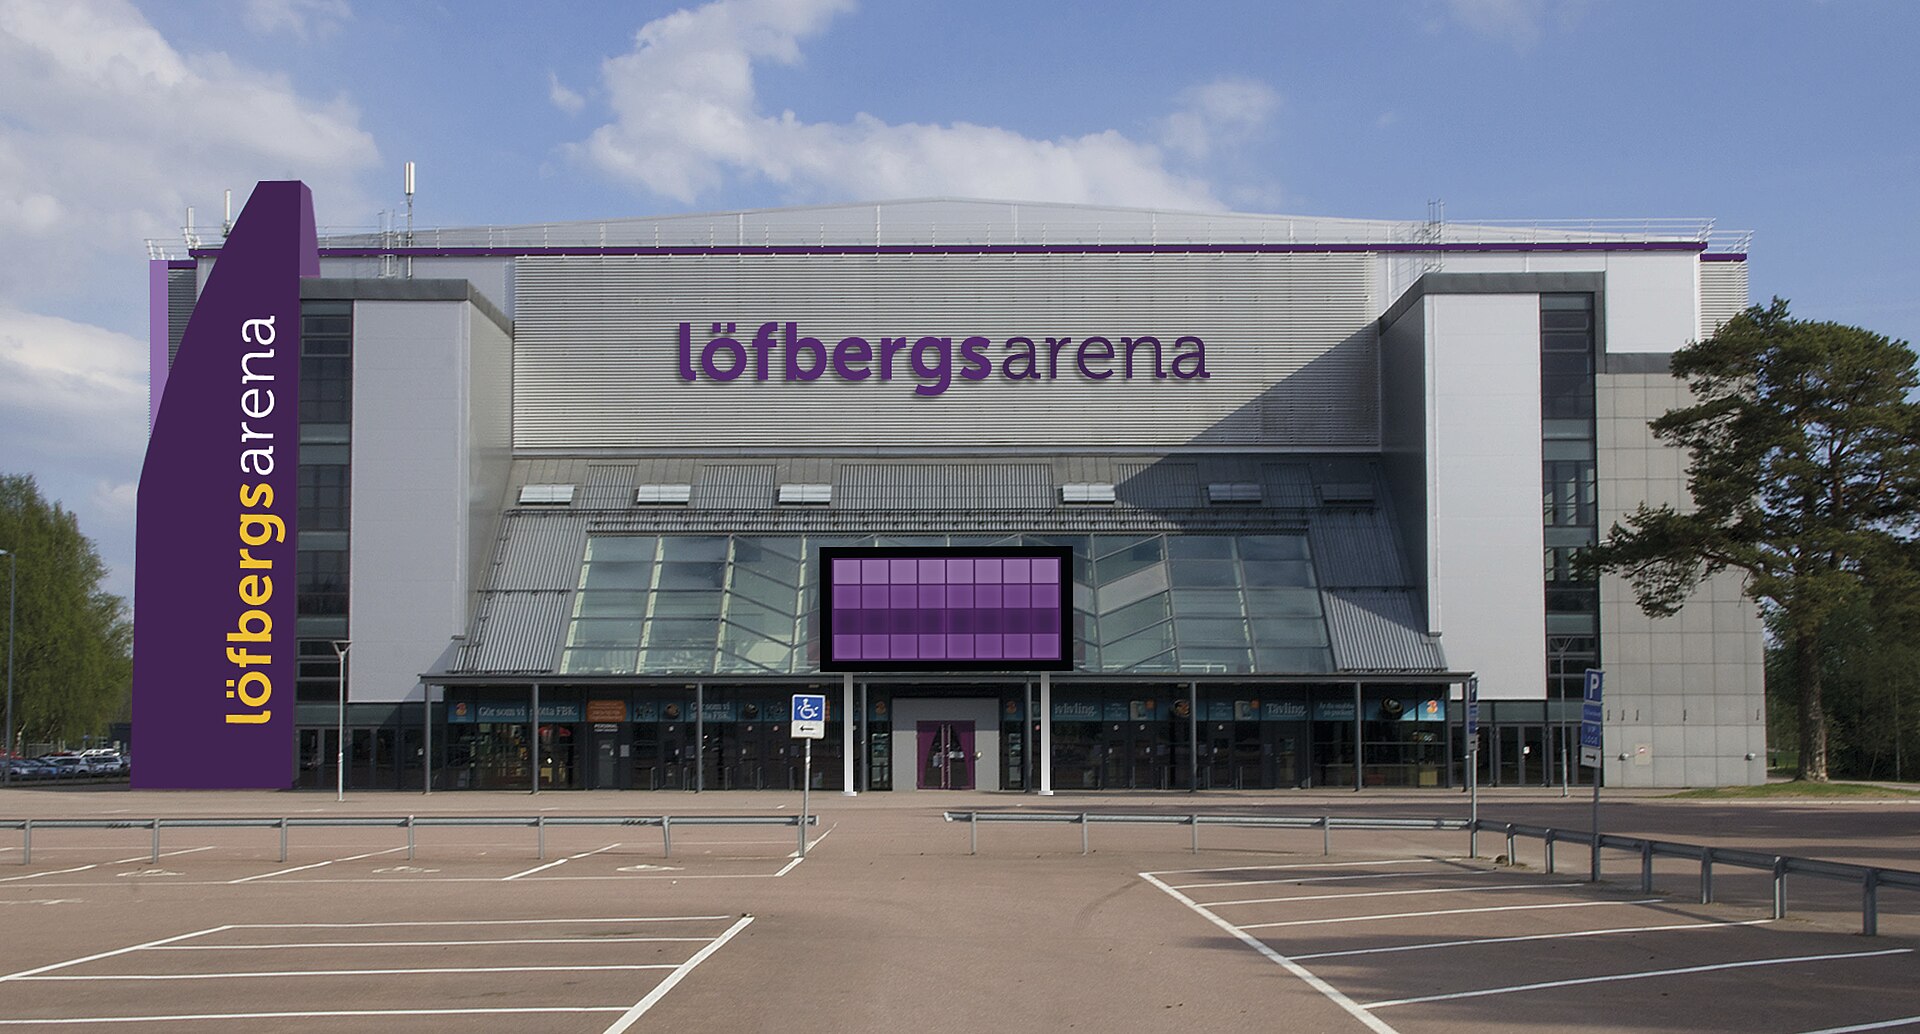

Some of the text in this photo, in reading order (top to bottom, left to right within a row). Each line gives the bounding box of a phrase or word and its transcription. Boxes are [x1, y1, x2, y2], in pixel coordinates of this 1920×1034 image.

[677, 321, 1212, 397] löfbergsarena
[225, 315, 286, 725] löfbergsarena
[1589, 673, 1599, 699] P
[496, 708, 515, 717] som
